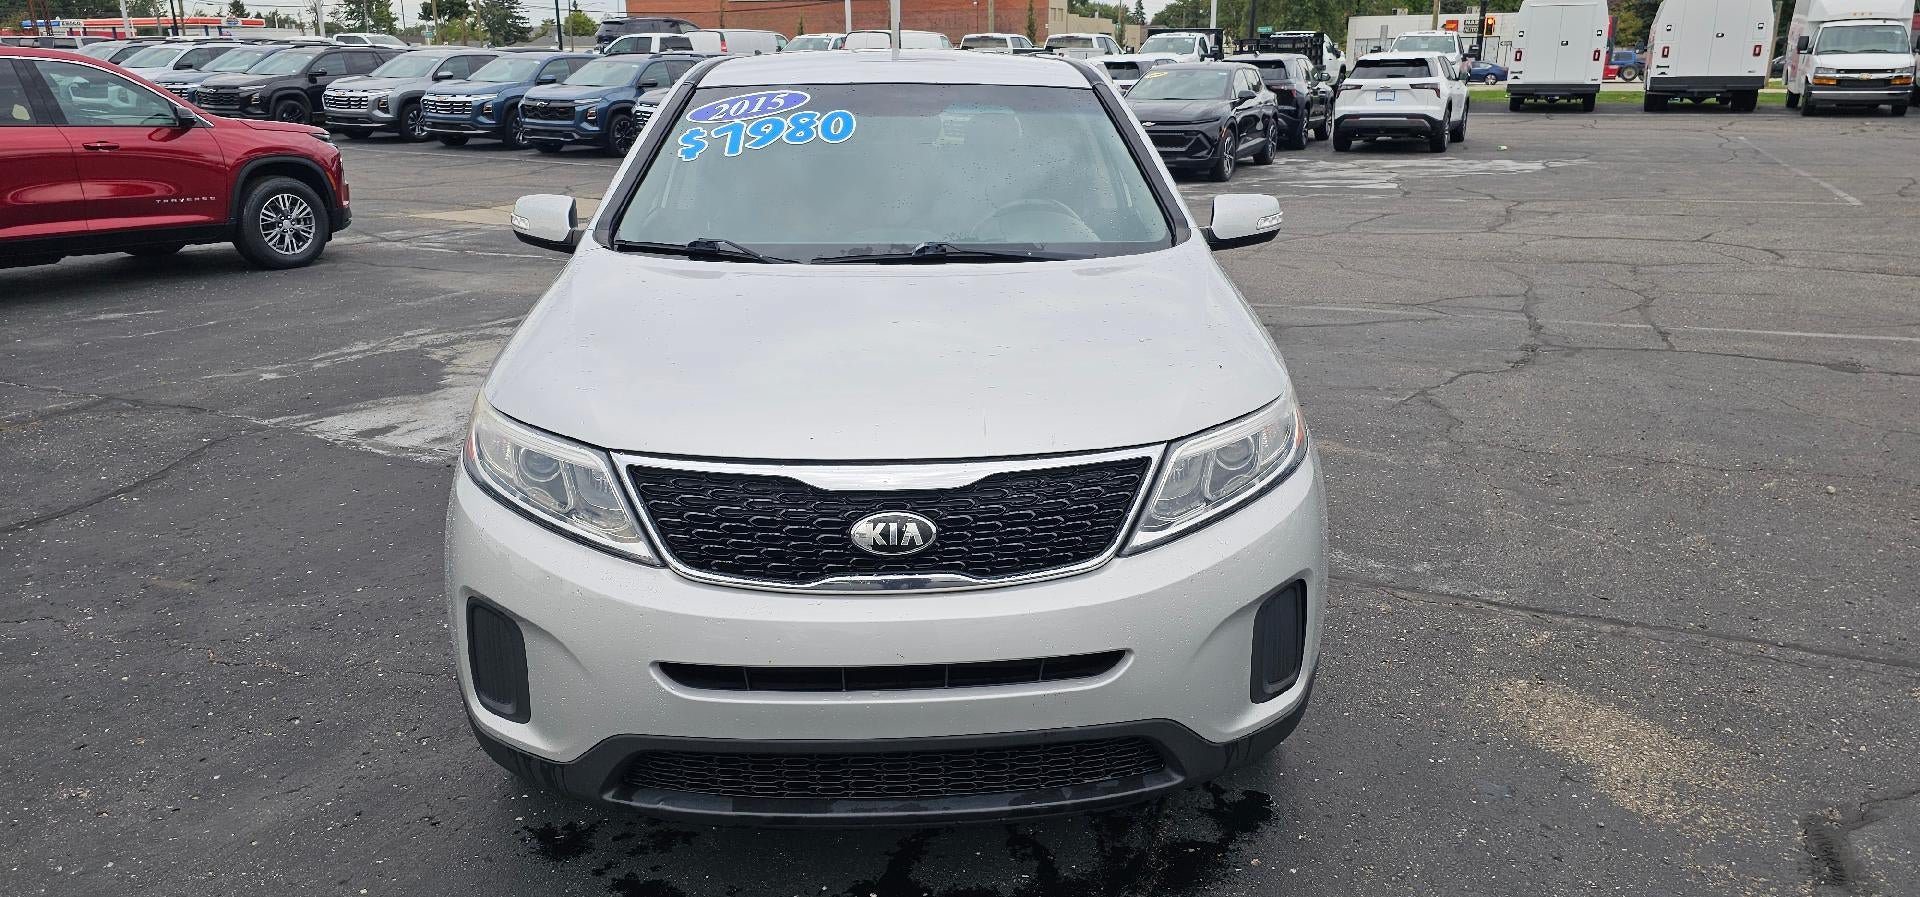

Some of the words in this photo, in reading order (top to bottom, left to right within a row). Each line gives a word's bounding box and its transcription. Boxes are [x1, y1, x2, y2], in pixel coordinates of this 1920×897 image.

[707, 92, 790, 121] 2015
[678, 110, 856, 161] $7980
[866, 522, 924, 546] KIA
